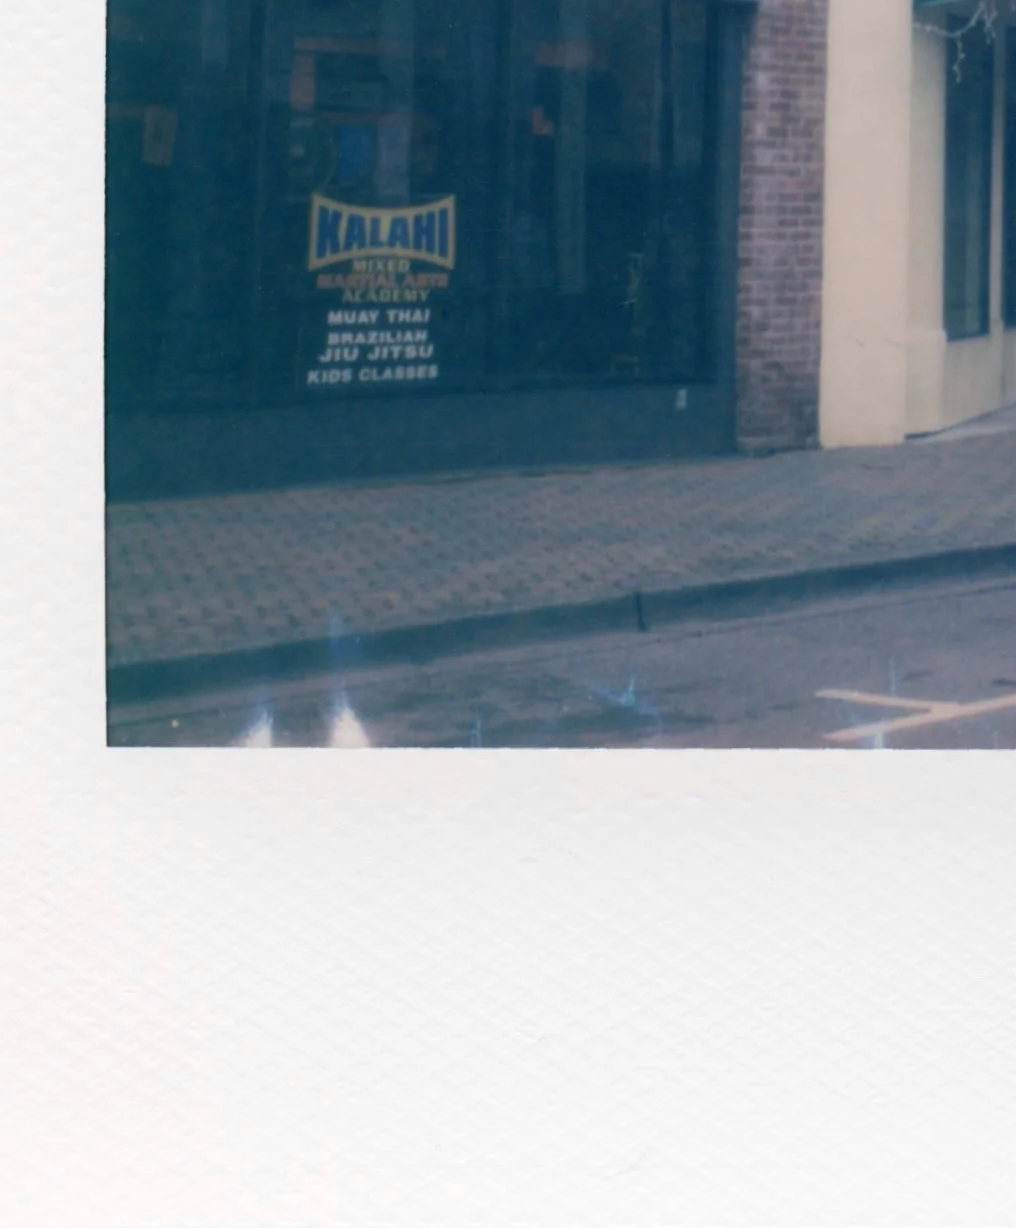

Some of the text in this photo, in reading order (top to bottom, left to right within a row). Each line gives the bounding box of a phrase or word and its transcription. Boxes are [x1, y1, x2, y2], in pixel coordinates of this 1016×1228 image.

[316, 204, 450, 259] KALAHI
[353, 259, 410, 272] MIXED
[316, 273, 396, 289] MARTIAL
[342, 288, 431, 303] ACADEMY
[327, 309, 431, 325] MUAY THAI
[327, 330, 428, 346] BRAZILIAN
[318, 344, 434, 363] JIU JITSU
[307, 365, 439, 385] KIDS CLASSES
